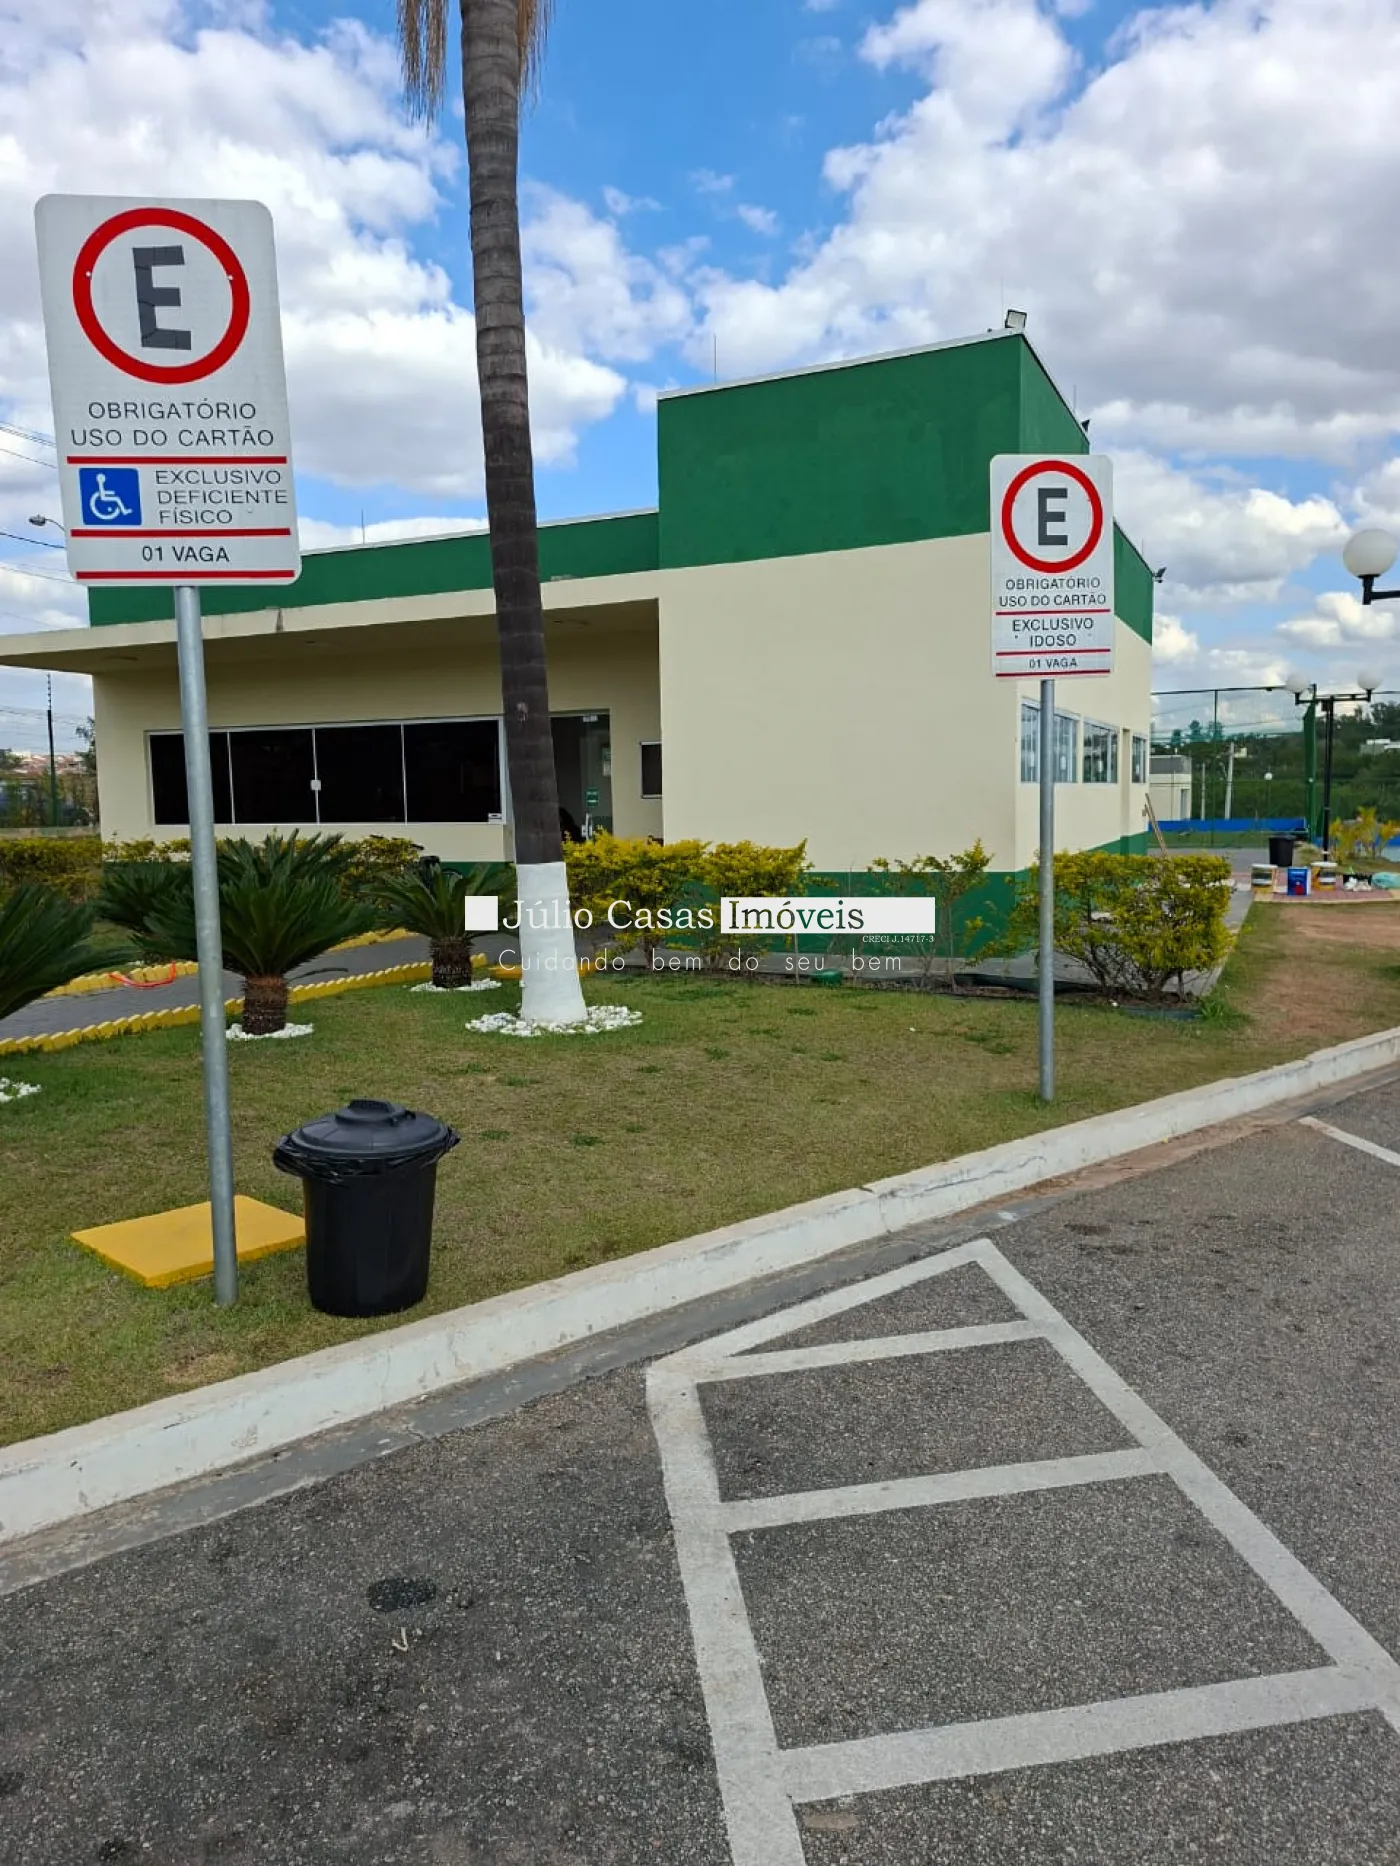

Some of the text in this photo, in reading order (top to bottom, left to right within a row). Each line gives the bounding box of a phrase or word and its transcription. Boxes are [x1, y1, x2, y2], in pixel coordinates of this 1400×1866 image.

[132, 245, 192, 351] E
[88, 398, 256, 419] OBRIGATÓRIO
[71, 425, 274, 447] USO DO CARTÃO
[155, 469, 281, 485] EXCLUSIVO
[157, 489, 288, 504] DEFICIENTE
[159, 507, 233, 524] FÍSICO
[1038, 488, 1068, 546] E
[142, 546, 230, 562] 01 VAGA
[1005, 576, 1101, 590] OBRIGATÓRIO
[999, 592, 1106, 607] USO DO CARTÃO
[1012, 617, 1094, 632] EXCLUSIVO
[1030, 634, 1077, 647] IDOSO
[1029, 657, 1078, 669] 01 VAGA
